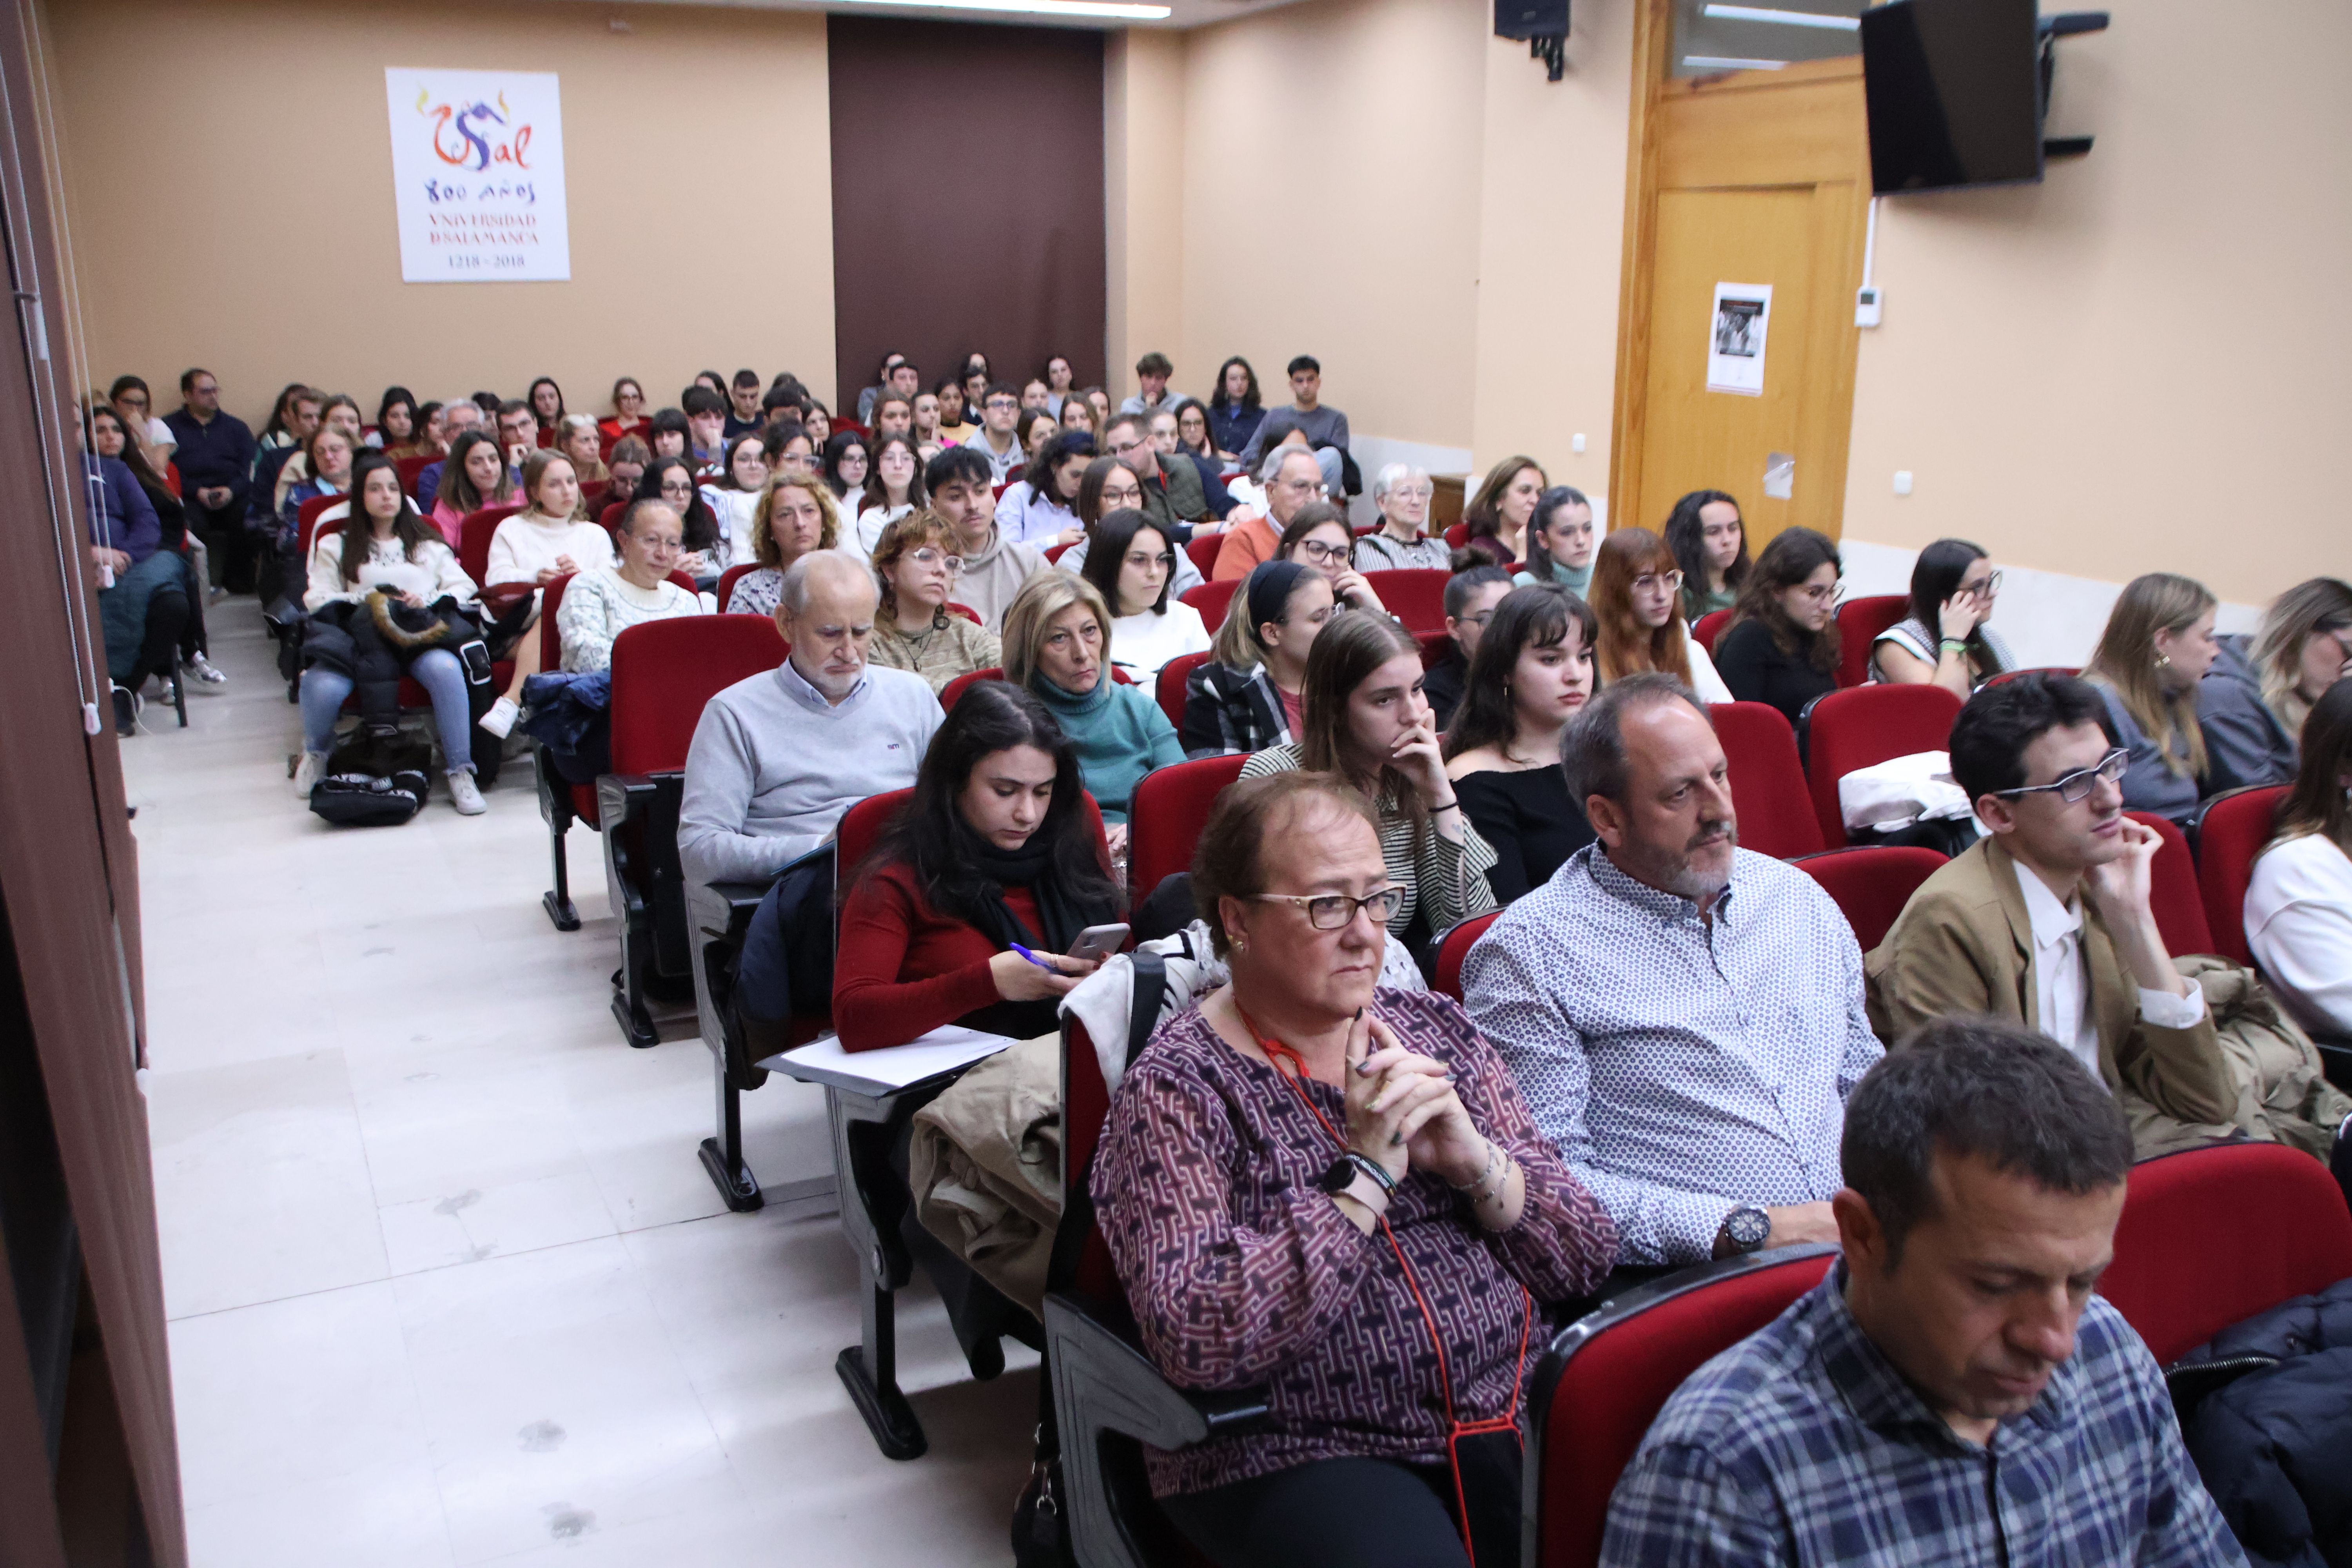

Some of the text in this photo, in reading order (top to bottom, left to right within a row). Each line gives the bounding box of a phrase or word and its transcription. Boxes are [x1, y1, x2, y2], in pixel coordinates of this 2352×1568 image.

[424, 178, 467, 205] 800
[448, 254, 480, 268] 1218
[494, 254, 526, 268] 2018
